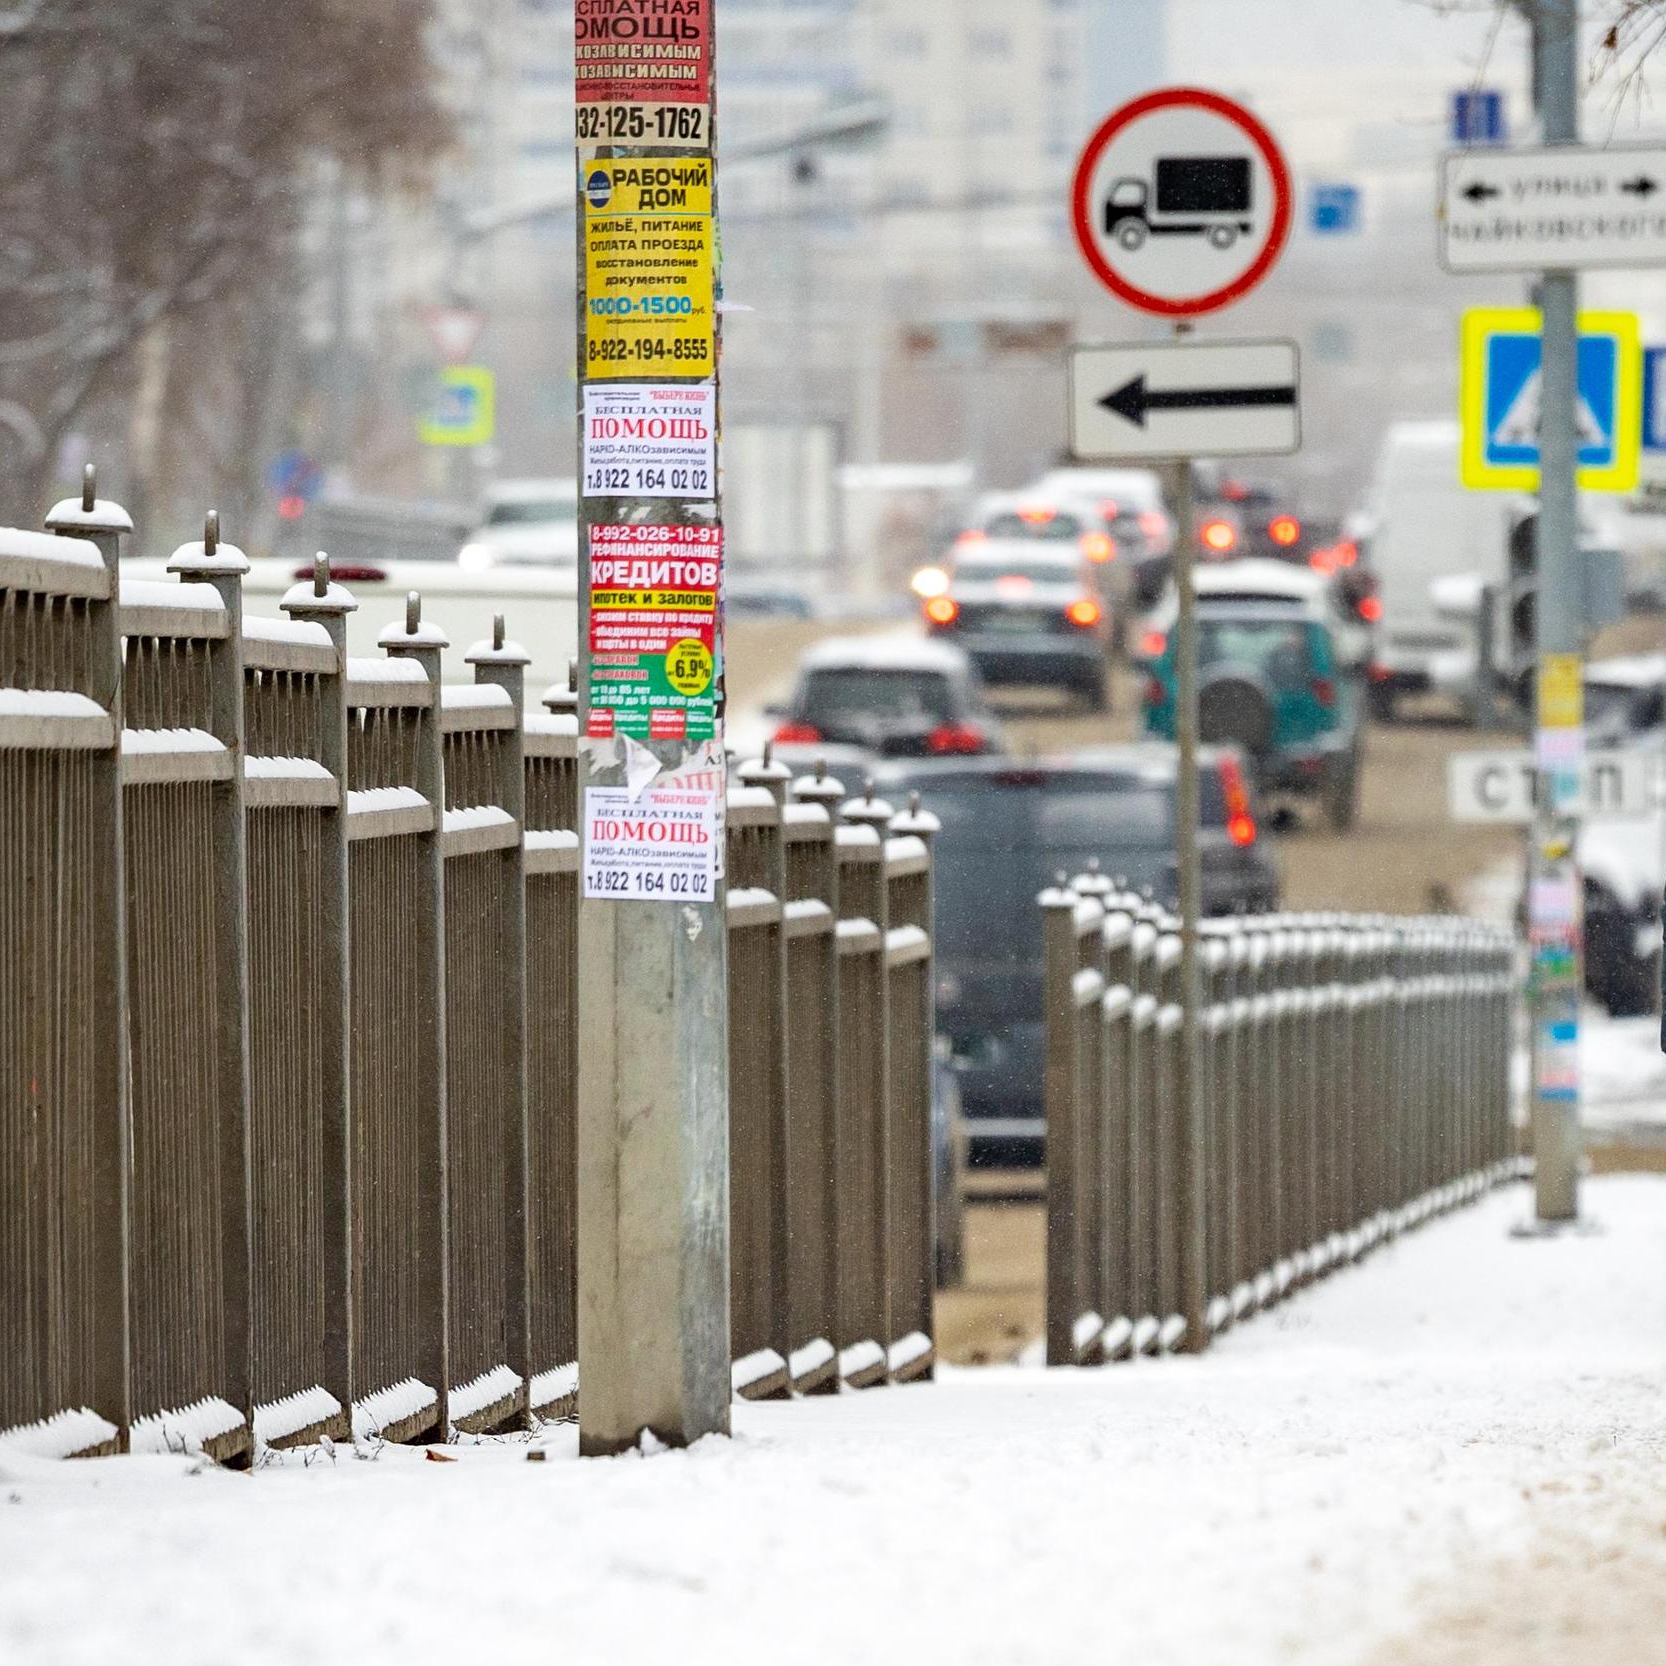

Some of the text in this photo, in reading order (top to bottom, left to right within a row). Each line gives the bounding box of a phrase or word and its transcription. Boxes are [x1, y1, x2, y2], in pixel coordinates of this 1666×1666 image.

[575, 0, 699, 15] СПЛАТНАЯ
[612, 163, 708, 187] РАБОЧИЙ
[638, 189, 687, 210] ДОМ
[591, 218, 703, 234] ЖИЛЬЁ, ПИТАНИЕ
[590, 239, 705, 252] ОПЛАТА ПРОЕЗДА
[595, 257, 699, 268] восстановление
[605, 275, 687, 287] документов
[588, 338, 708, 361] 8-922-194-8555
[595, 406, 702, 415] БЕСПЛАТНАЯ
[591, 418, 708, 442] ПОМОЩЬ
[636, 468, 666, 490] 164
[671, 469, 688, 490] 02
[692, 469, 708, 490] 02
[592, 525, 720, 543] 8-992-026-10-91
[591, 543, 720, 558] РЕФИНАНСИРОВАНИЕ
[590, 560, 718, 588] КРЕДИТОВ
[593, 593, 713, 606] ипотек и залогов
[597, 808, 703, 819] БЕСПЛАТНАЯ
[592, 820, 709, 846] ПОМОЩЬ
[635, 872, 665, 891] 164
[670, 873, 689, 892] 02
[692, 873, 708, 893] 02
